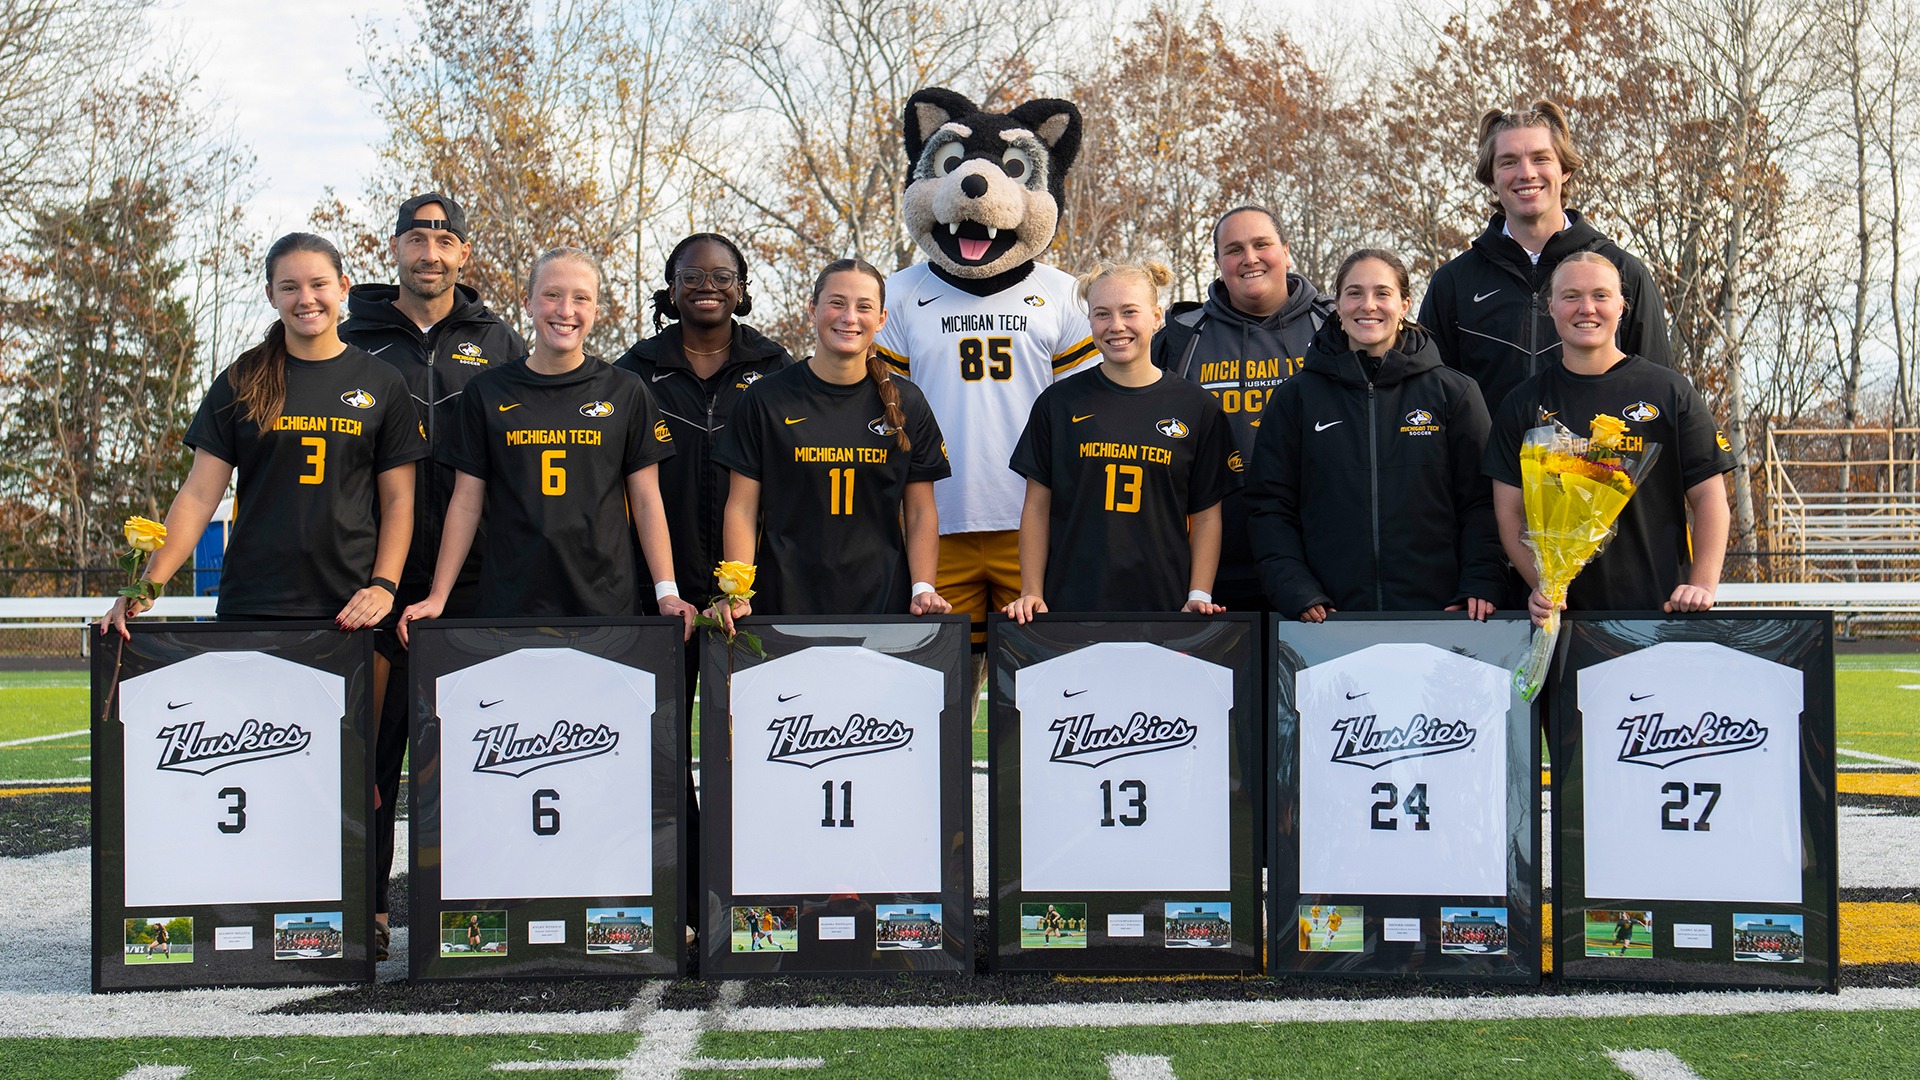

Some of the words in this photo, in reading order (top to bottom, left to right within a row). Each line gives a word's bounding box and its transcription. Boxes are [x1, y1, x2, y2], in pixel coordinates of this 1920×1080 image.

[941, 314, 994, 333] MICHIGAN
[998, 315, 1027, 332] TECH
[958, 336, 1013, 383] 85
[1200, 358, 1279, 383] MICHGAN
[329, 417, 362, 436] TECH
[506, 430, 566, 447] MICHIGAN
[568, 429, 601, 446] TECH
[1612, 436, 1643, 452] ECH
[299, 437, 326, 485] 3
[541, 449, 566, 496] 6
[794, 447, 854, 463] MICHIGAN
[856, 448, 887, 464] TECH
[1079, 443, 1137, 460] MICHIGAN
[1140, 445, 1172, 466] TECH
[829, 468, 855, 515] 11
[1104, 463, 1143, 513] 13
[155, 718, 312, 776] Huskies
[472, 719, 619, 778] Huskies
[766, 713, 914, 769] Huskies
[1048, 711, 1197, 768] Huskies
[1330, 713, 1477, 770] Huskies
[1616, 711, 1769, 769] Huskies
[217, 786, 247, 834] 3
[532, 788, 560, 836] 6
[821, 780, 854, 827] 11
[1099, 779, 1147, 827] 13
[1370, 782, 1430, 831] 24
[1661, 781, 1721, 831] 27
